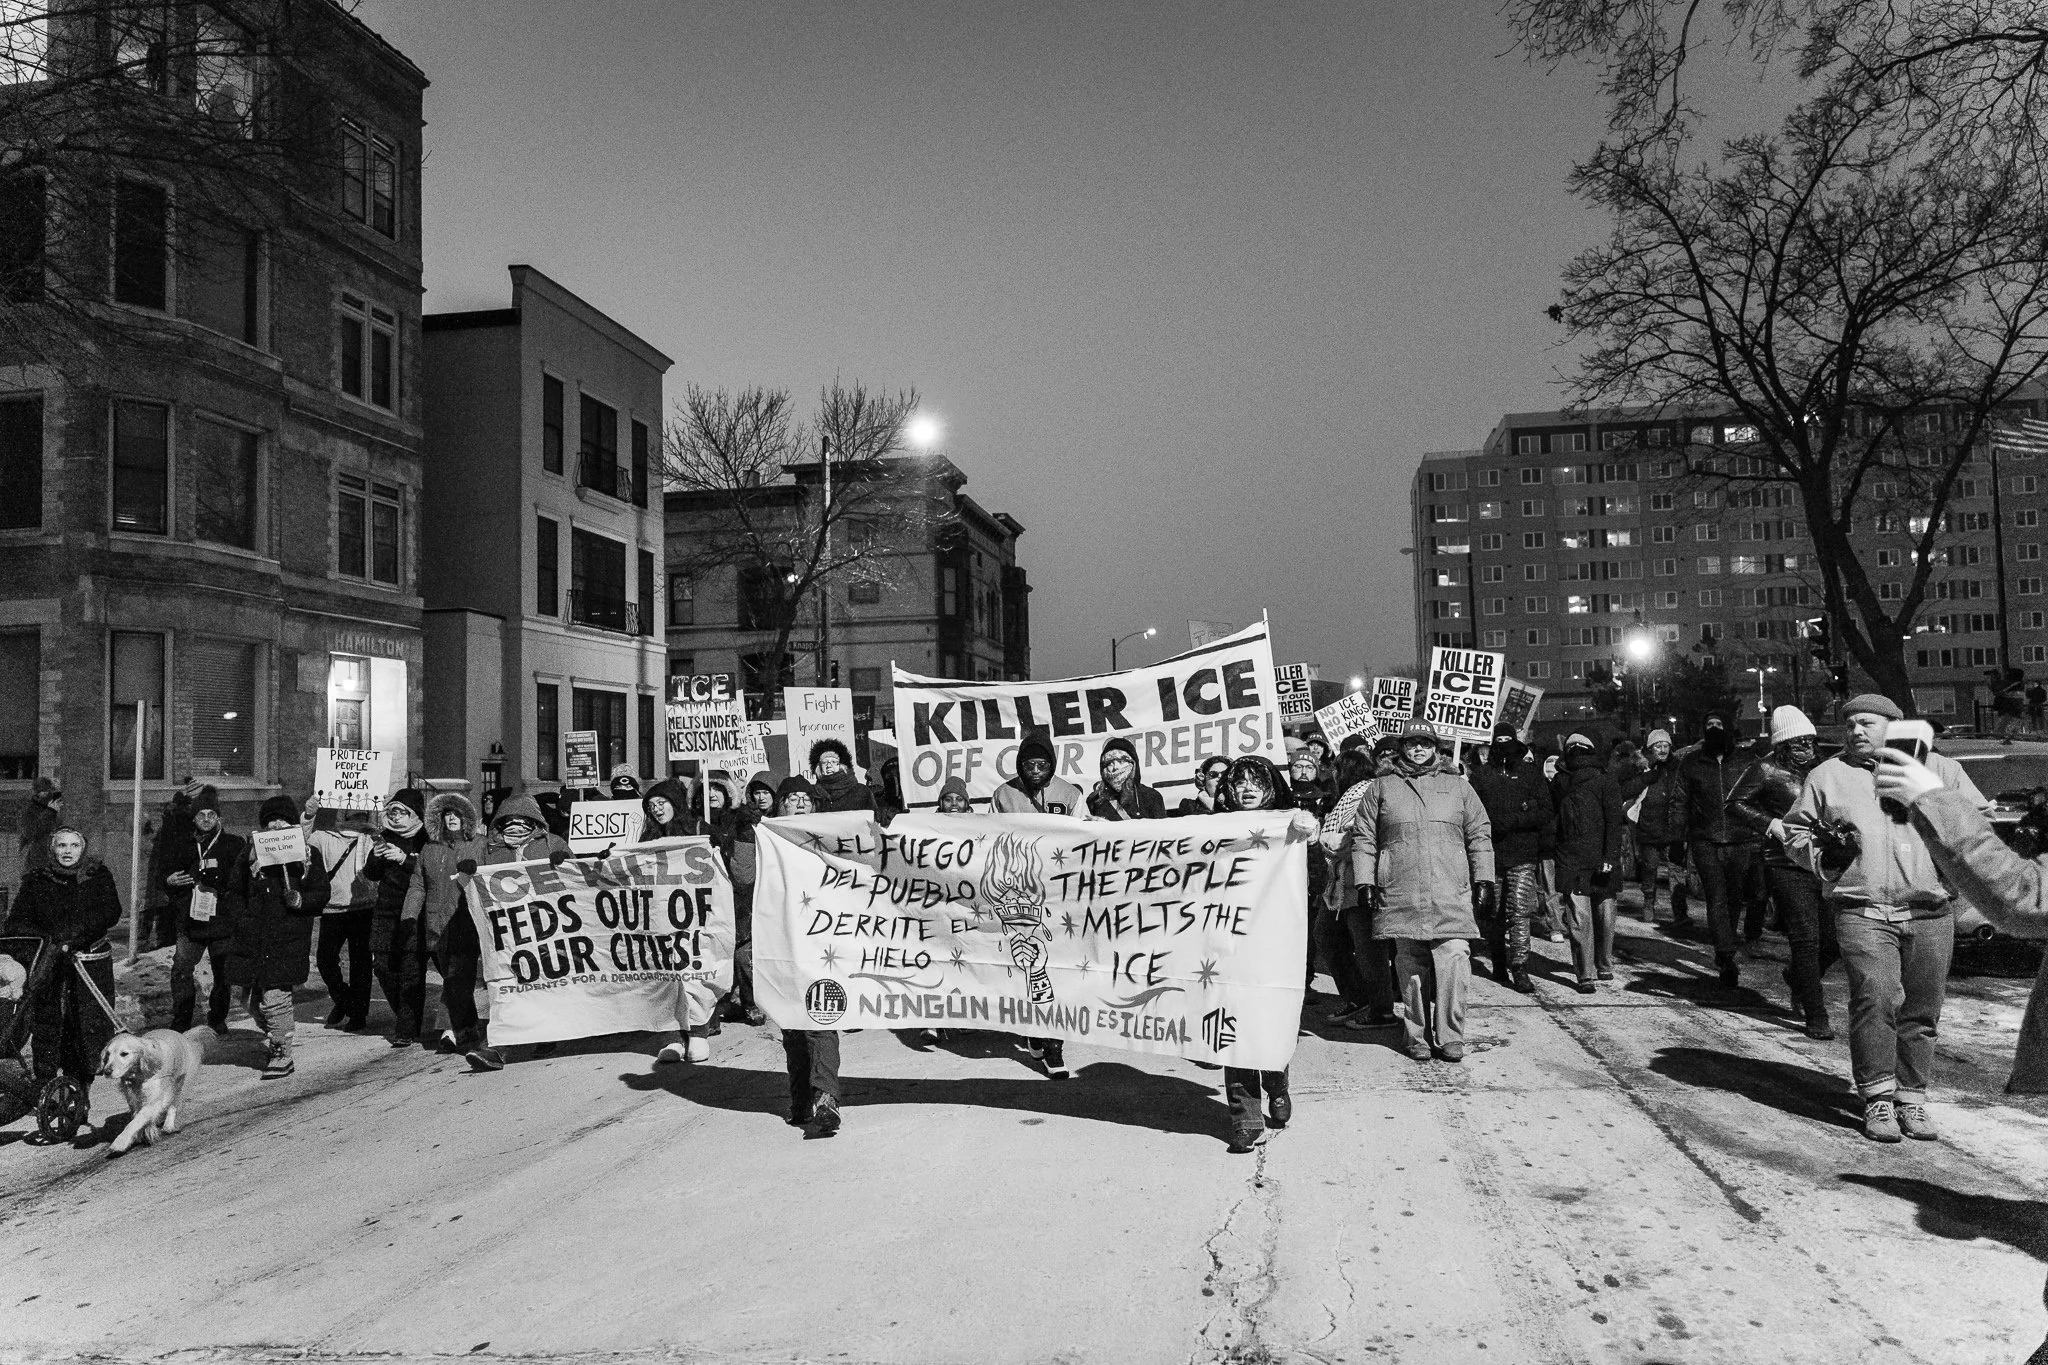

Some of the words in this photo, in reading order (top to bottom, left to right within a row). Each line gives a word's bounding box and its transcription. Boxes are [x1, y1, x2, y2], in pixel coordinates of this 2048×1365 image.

[334, 631, 404, 657] HAMILTON
[793, 641, 813, 651] Knapp
[1274, 665, 1303, 681] ILLER
[1439, 650, 1494, 676] KILLER
[671, 674, 730, 701] ICE
[1276, 679, 1308, 694] CE
[1378, 678, 1411, 697] KILLER
[1432, 670, 1496, 696] ICE
[803, 692, 840, 713] Fight
[914, 686, 1132, 747] KILLER
[1157, 658, 1261, 723] ICE
[1289, 692, 1309, 700] OUR
[1319, 706, 1336, 719] NO
[1339, 696, 1357, 710] ICE
[1373, 694, 1411, 711] ICE
[1430, 692, 1460, 703] OFF
[1462, 697, 1494, 709] OUR
[668, 716, 700, 730] MELTS
[703, 714, 738, 729] UNDER
[798, 716, 845, 736] Ignorance
[1324, 716, 1340, 729] NO
[1341, 702, 1370, 721] KINGS
[1374, 716, 1406, 734] TREET
[1392, 711, 1411, 719] OUR
[1426, 702, 1493, 730] STREETS
[757, 721, 772, 736] IS
[1328, 726, 1345, 740] NO
[1345, 715, 1369, 732] KKK
[669, 730, 741, 753] RESISTANCE
[330, 749, 380, 760] PROTECT
[335, 762, 368, 771] PEOPLE
[912, 747, 983, 788] OFF
[996, 743, 1084, 781] OR
[335, 780, 368, 790] POWER
[342, 772, 361, 780] NOT
[571, 812, 629, 836] RESIST
[258, 836, 280, 844] Come
[279, 843, 293, 851] Line
[1072, 839, 1125, 867] THE
[1129, 836, 1195, 862] FIRE
[1200, 838, 1237, 855] OF
[835, 834, 874, 854] EL
[879, 834, 974, 871] FUEGO
[473, 863, 566, 908] ICE
[578, 846, 715, 887] KILLS
[820, 866, 866, 889] DEL
[868, 874, 976, 909] PUEBLO
[1050, 869, 1120, 902] THE
[1125, 857, 1259, 895] PEOPLE
[488, 894, 582, 951] FEDS
[595, 889, 653, 930] OUT
[668, 888, 712, 930] OF
[807, 910, 936, 940] DERRITE
[951, 919, 979, 933] EL
[1082, 901, 1195, 941] MELTS
[1203, 903, 1251, 936] THE
[511, 935, 600, 984] OUR
[610, 930, 703, 971] CITIES!
[861, 946, 932, 970] HIELO
[1113, 950, 1173, 988] ICE
[500, 979, 568, 994] STUDENTS
[573, 973, 596, 984] FOR
[600, 974, 607, 982] A
[670, 969, 717, 982] SOCIETY
[999, 996, 1090, 1035] HUMANO
[1096, 1009, 1118, 1029] ES
[1120, 1011, 1193, 1044] ILEGAL
